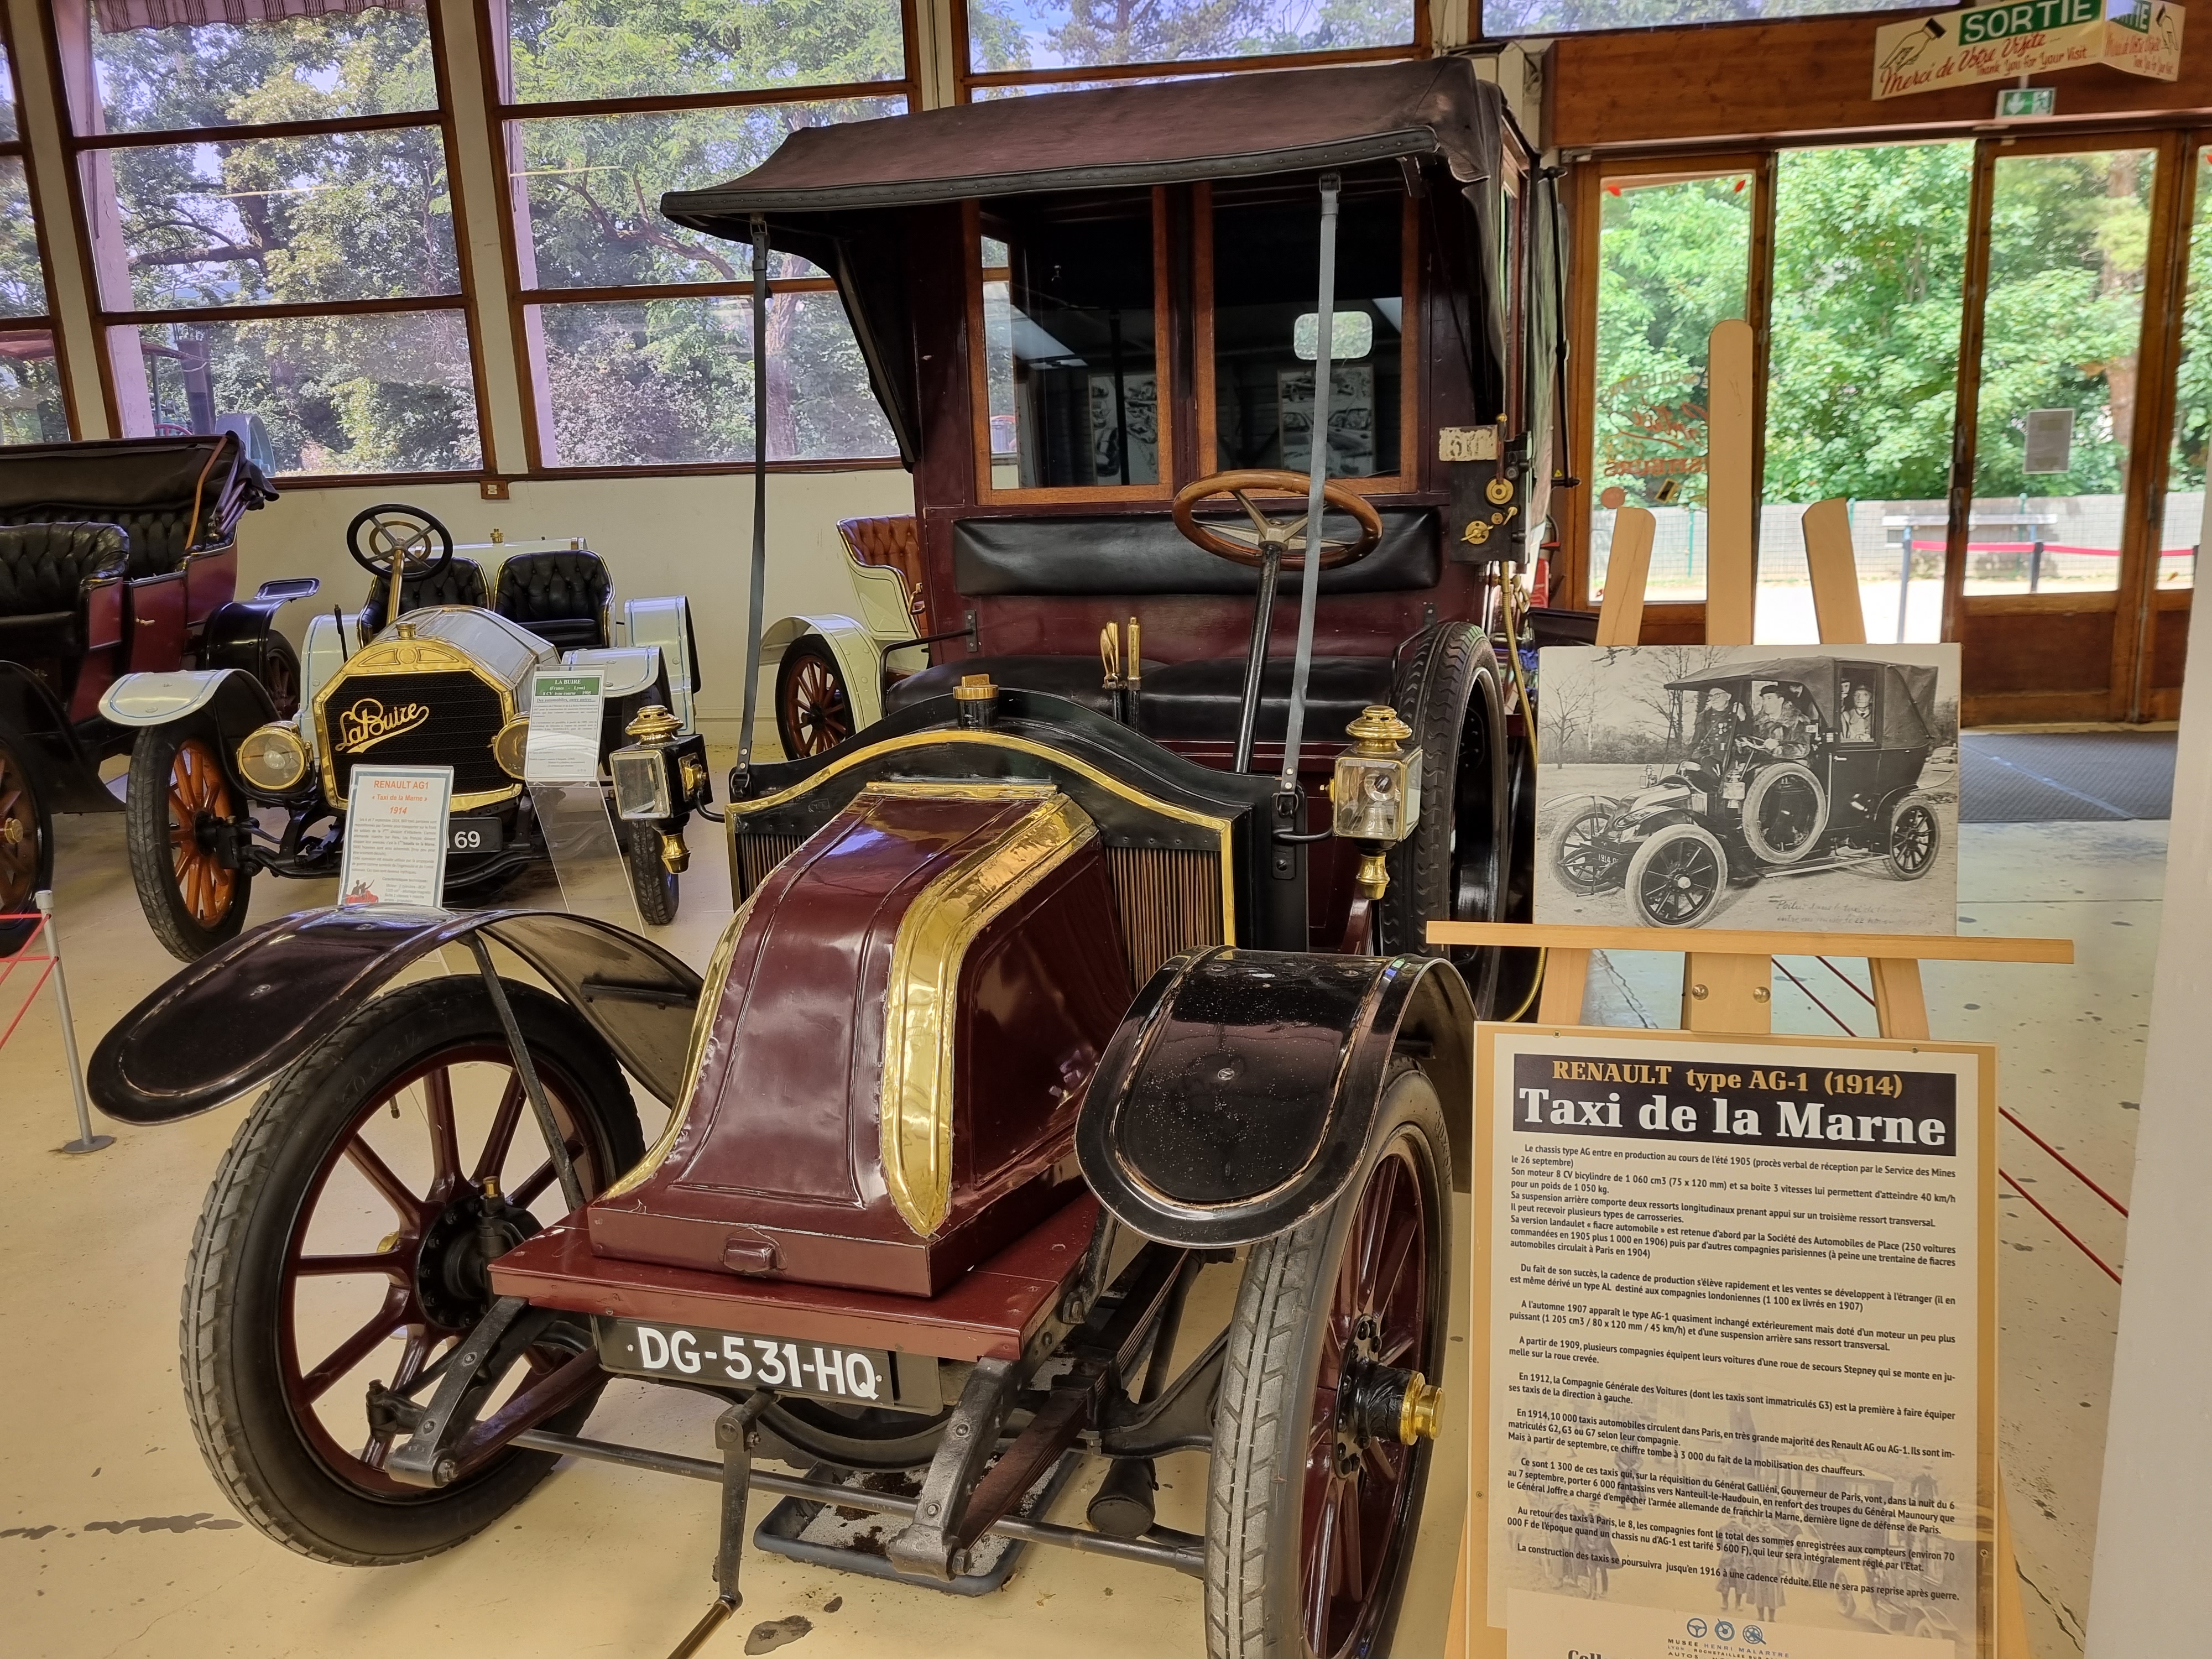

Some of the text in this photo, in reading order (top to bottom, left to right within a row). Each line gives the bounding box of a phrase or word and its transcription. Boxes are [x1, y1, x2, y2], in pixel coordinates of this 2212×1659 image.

[1964, 0, 2092, 43] SORTIE
[374, 780, 429, 790] RENAULT AG1
[390, 806, 408, 815] 1914
[454, 831, 481, 848] 69
[1552, 1061, 1902, 1098] RENAULT type AG-1 (1914)
[1519, 1088, 1945, 1145] Taxi de la Marne
[1511, 1154, 1574, 1169] le 26 septembre)
[1510, 1180, 1528, 1190] pour
[1540, 1181, 1562, 1191] poids
[1562, 1182, 1573, 1191] de
[1580, 1183, 1597, 1193] 050
[1597, 1184, 1610, 1196] kg.
[1510, 1190, 1520, 1199] Sa
[1521, 1192, 1563, 1203] suspension
[1563, 1194, 1589, 1204] arrière
[1590, 1197, 1627, 1208] comporte
[1627, 1198, 1648, 1209] deux
[1648, 1201, 1679, 1211] ressorts
[1680, 1202, 1735, 1214] longitudinaux
[1735, 1207, 1768, 1217] prenant
[1768, 1209, 1791, 1219] appui
[1792, 1211, 1806, 1219] sur
[1806, 1212, 1818, 1220] un
[1858, 1215, 1888, 1225] ressort
[1510, 1202, 1684, 1224] Il peut recevoir plusieurs types de carrosseries.
[1527, 1300, 1566, 1312] l'automne
[1567, 1303, 1588, 1314] 1907
[1588, 1307, 1621, 1317] apparaît
[1621, 1308, 1630, 1318] le
[1631, 1310, 1650, 1321] type
[1650, 1310, 1670, 1321] AG-1
[1671, 1313, 1713, 1325] quasiment
[1714, 1315, 1750, 1329] inchangé
[1751, 1319, 1814, 1333] extérieurement
[1814, 1324, 1835, 1335] mais
[1835, 1325, 1855, 1336] doté
[1856, 1327, 1874, 1338] d'un
[1875, 1330, 1906, 1340] moteur
[1907, 1333, 1919, 1341] un
[1919, 1333, 1937, 1343] peu
[1937, 1333, 1956, 1345] plus
[637, 1327, 879, 1400] DG-531-HQ
[1507, 1384, 1521, 1392] ses
[1521, 1385, 1541, 1395] taxis
[1541, 1386, 1552, 1396] de
[1552, 1387, 1561, 1397] la
[1561, 1388, 1596, 1401] direction
[1603, 1394, 1634, 1405] gauche.
[1507, 1431, 1526, 1442] Mais
[1532, 1435, 1555, 1445] partir
[1555, 1437, 1566, 1447] de
[1566, 1439, 1610, 1453] septembre,
[1609, 1444, 1619, 1453] ce
[1620, 1444, 1646, 1455] chiffre
[1646, 1447, 1673, 1458] tombe
[1687, 1451, 1704, 1462] 000
[1704, 1452, 1716, 1463] du
[1717, 1453, 1731, 1464] fait
[1732, 1455, 1743, 1465] de
[1744, 1456, 1752, 1466] la
[1753, 1458, 1804, 1472] mobilisation
[1804, 1462, 1819, 1473] des
[1820, 1464, 1866, 1477] chauffeurs.
[1516, 1542, 1527, 1552] La
[1527, 1546, 1574, 1559] construction
[1575, 1550, 1589, 1561] des
[1590, 1552, 1610, 1563] taxis
[1610, 1556, 1620, 1565] se
[1621, 1558, 1662, 1571] poursuivra
[1666, 1561, 1698, 1574] jusqu'en
[1699, 1566, 1721, 1577] 1916
[1729, 1571, 1745, 1580] une
[1745, 1572, 1779, 1584] cadence
[1780, 1574, 1811, 1587] réduite.
[1812, 1578, 1828, 1589] Elle
[1829, 1582, 1840, 1590] ne
[1841, 1583, 1859, 1592] sera
[1860, 1585, 1875, 1595] pas
[1876, 1585, 1905, 1597] reprise
[1905, 1588, 1929, 1599] après
[1929, 1591, 1960, 1601] guerre.
[1668, 1638, 1790, 1658] MUSEE HENRI MALARTRE
